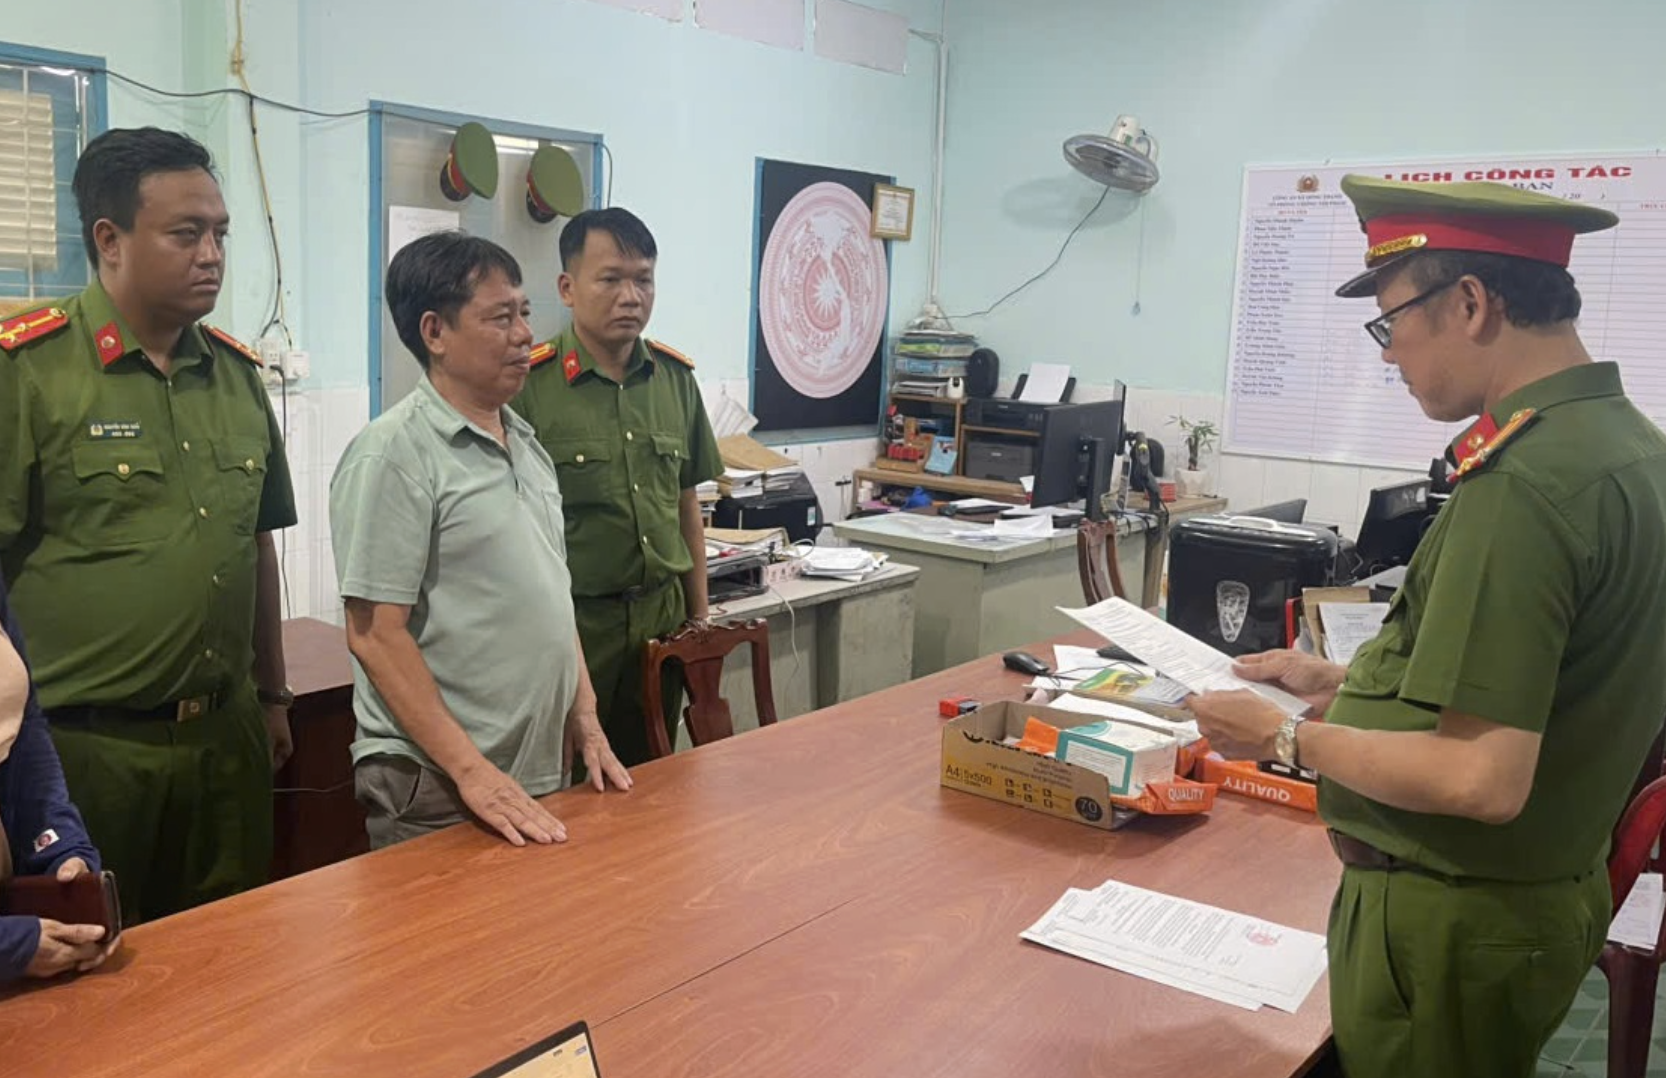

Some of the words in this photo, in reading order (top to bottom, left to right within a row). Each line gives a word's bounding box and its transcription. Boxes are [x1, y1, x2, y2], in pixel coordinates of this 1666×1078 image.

[1464, 168, 1554, 181] CÔNG
[1567, 164, 1632, 178] TÁC
[945, 764, 960, 777] A4
[964, 769, 992, 786] 5x500
[1168, 786, 1205, 802] QUALITY
[1222, 776, 1291, 802] QUALITY
[1079, 798, 1098, 814] 70
